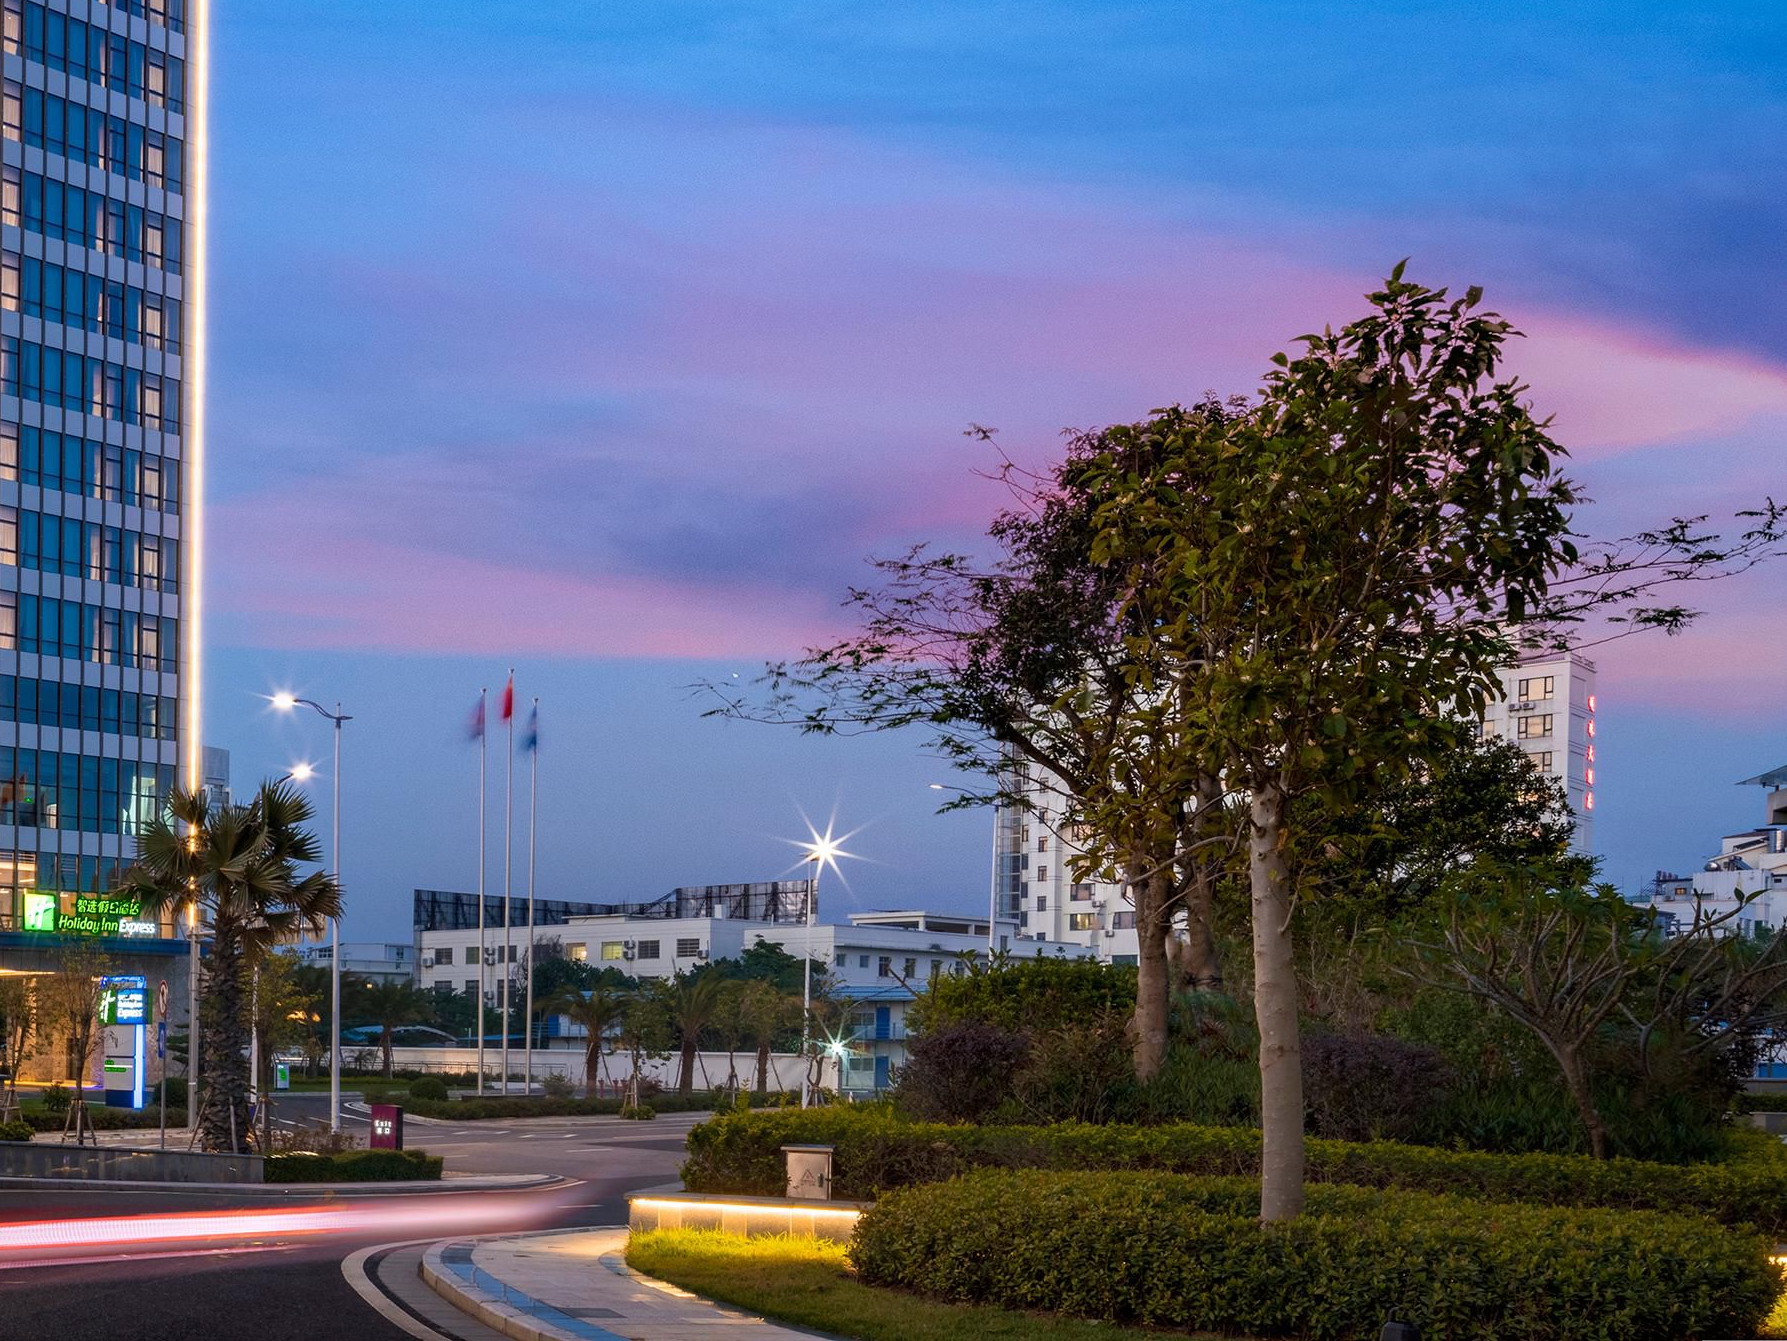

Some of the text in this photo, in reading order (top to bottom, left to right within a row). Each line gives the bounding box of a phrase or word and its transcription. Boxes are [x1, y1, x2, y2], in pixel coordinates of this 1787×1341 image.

[58, 915, 156, 935] Holiday Inn Express
